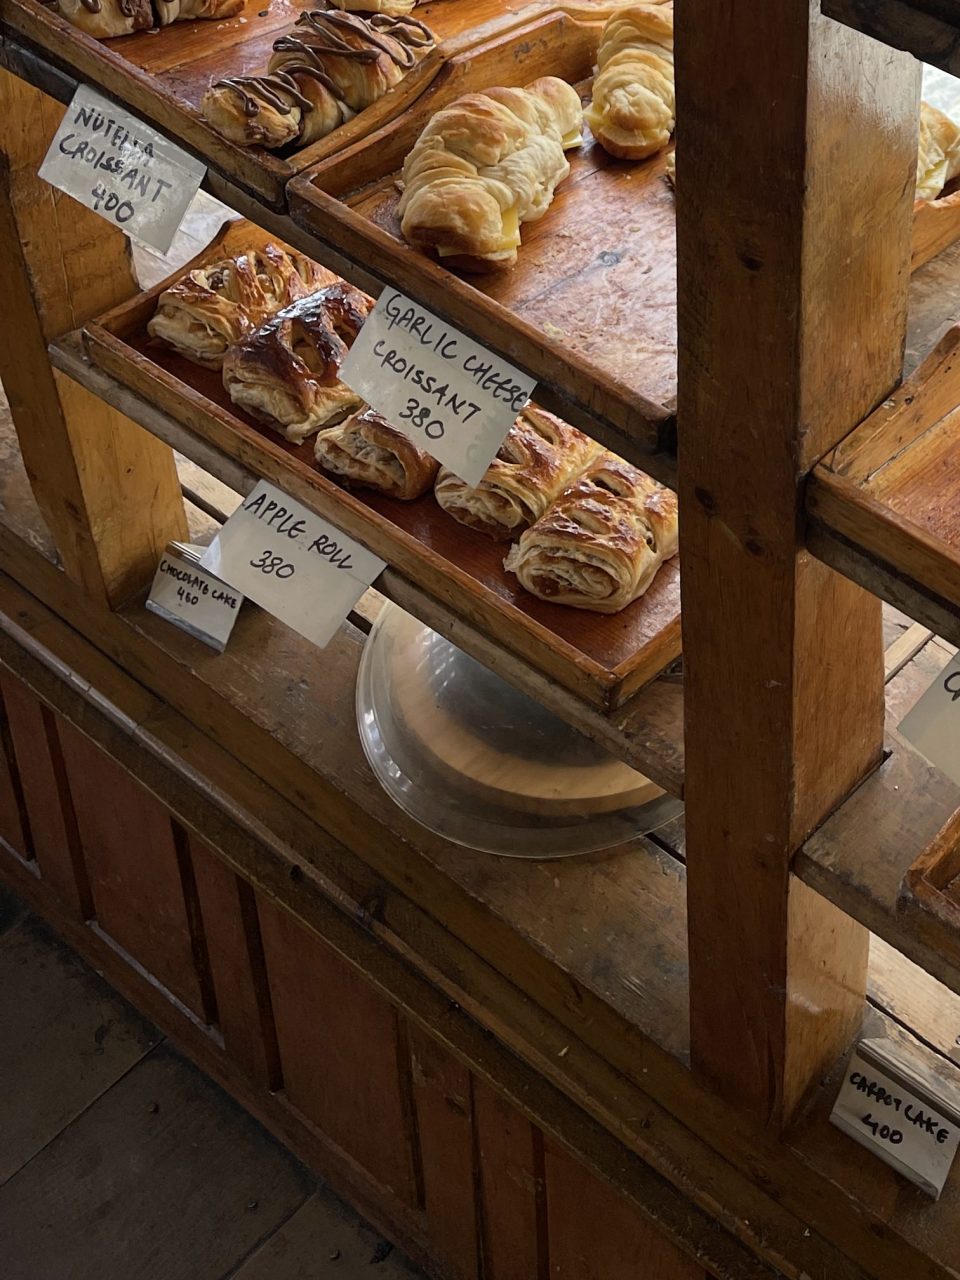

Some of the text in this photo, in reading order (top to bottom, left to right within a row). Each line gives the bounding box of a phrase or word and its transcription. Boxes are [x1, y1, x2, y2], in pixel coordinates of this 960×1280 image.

[59, 134, 172, 202] CROISSANT
[91, 183, 135, 222] 400
[373, 340, 482, 423] CROISSANT
[385, 293, 530, 413] GARLIC CHEESE
[399, 398, 445, 439] 380
[243, 493, 353, 570] APPLE ROLL
[160, 560, 237, 609] CHOCOLATE CAKE
[249, 550, 295, 579] 380
[850, 1072, 949, 1143] CARROT CAKE
[861, 1113, 903, 1144] 400
